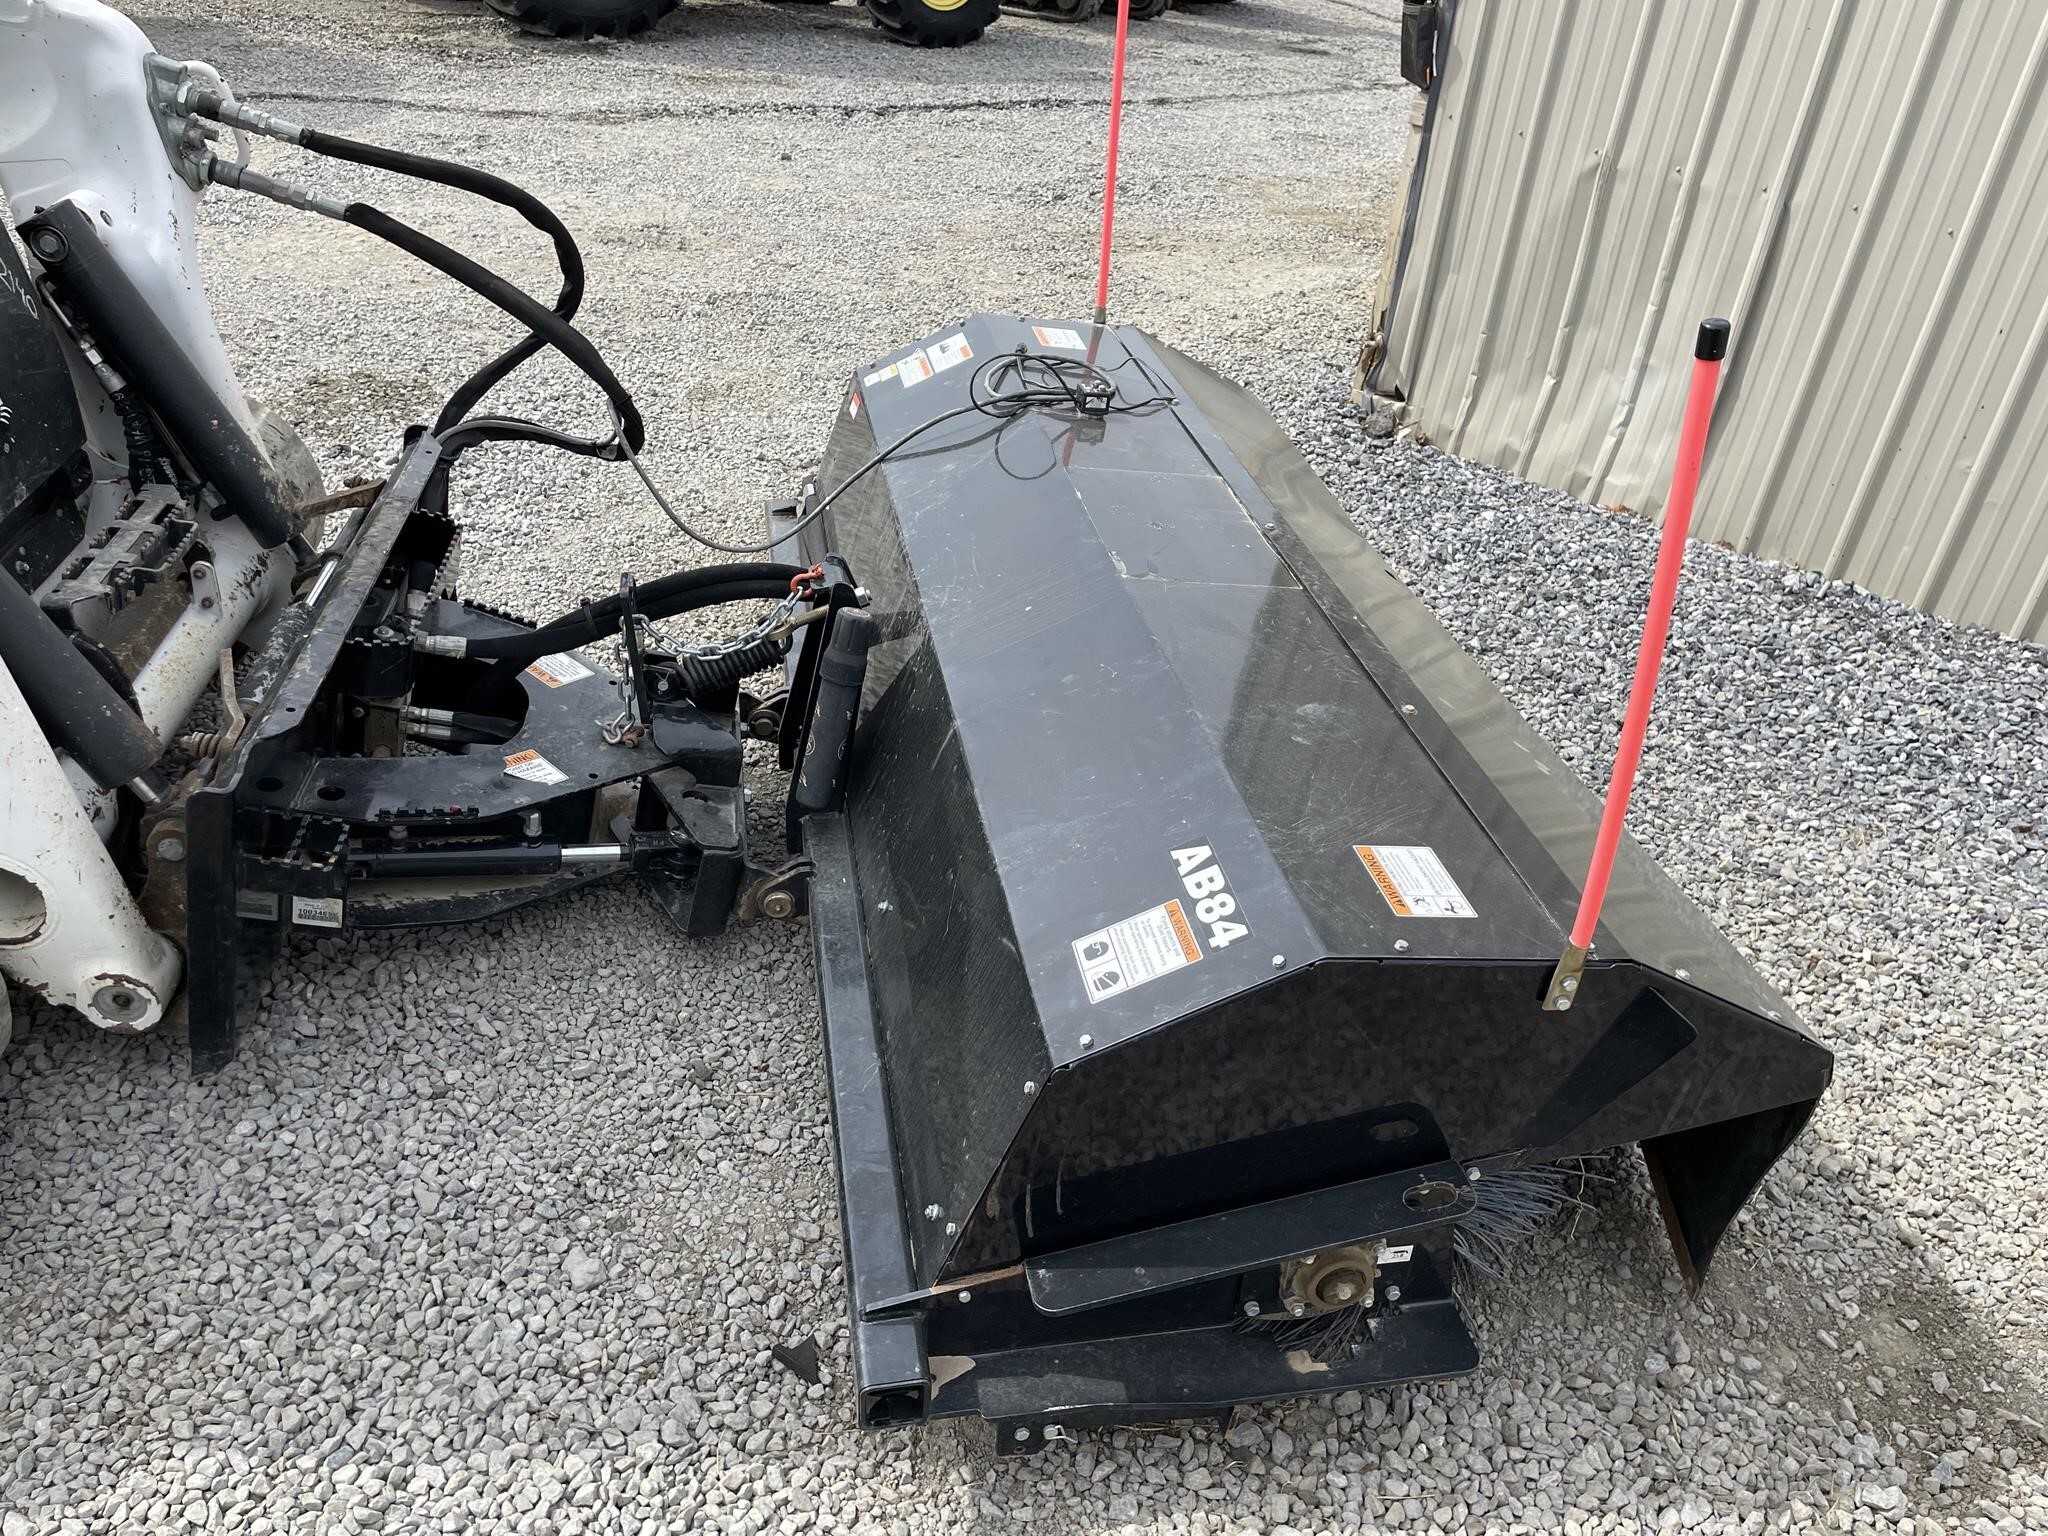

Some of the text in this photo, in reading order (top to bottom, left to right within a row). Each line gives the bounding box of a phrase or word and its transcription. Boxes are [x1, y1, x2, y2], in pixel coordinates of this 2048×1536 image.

[1169, 845, 1248, 949] AB84
[1363, 853, 1401, 902] WARNING
[1171, 916, 1195, 956] WARNING
